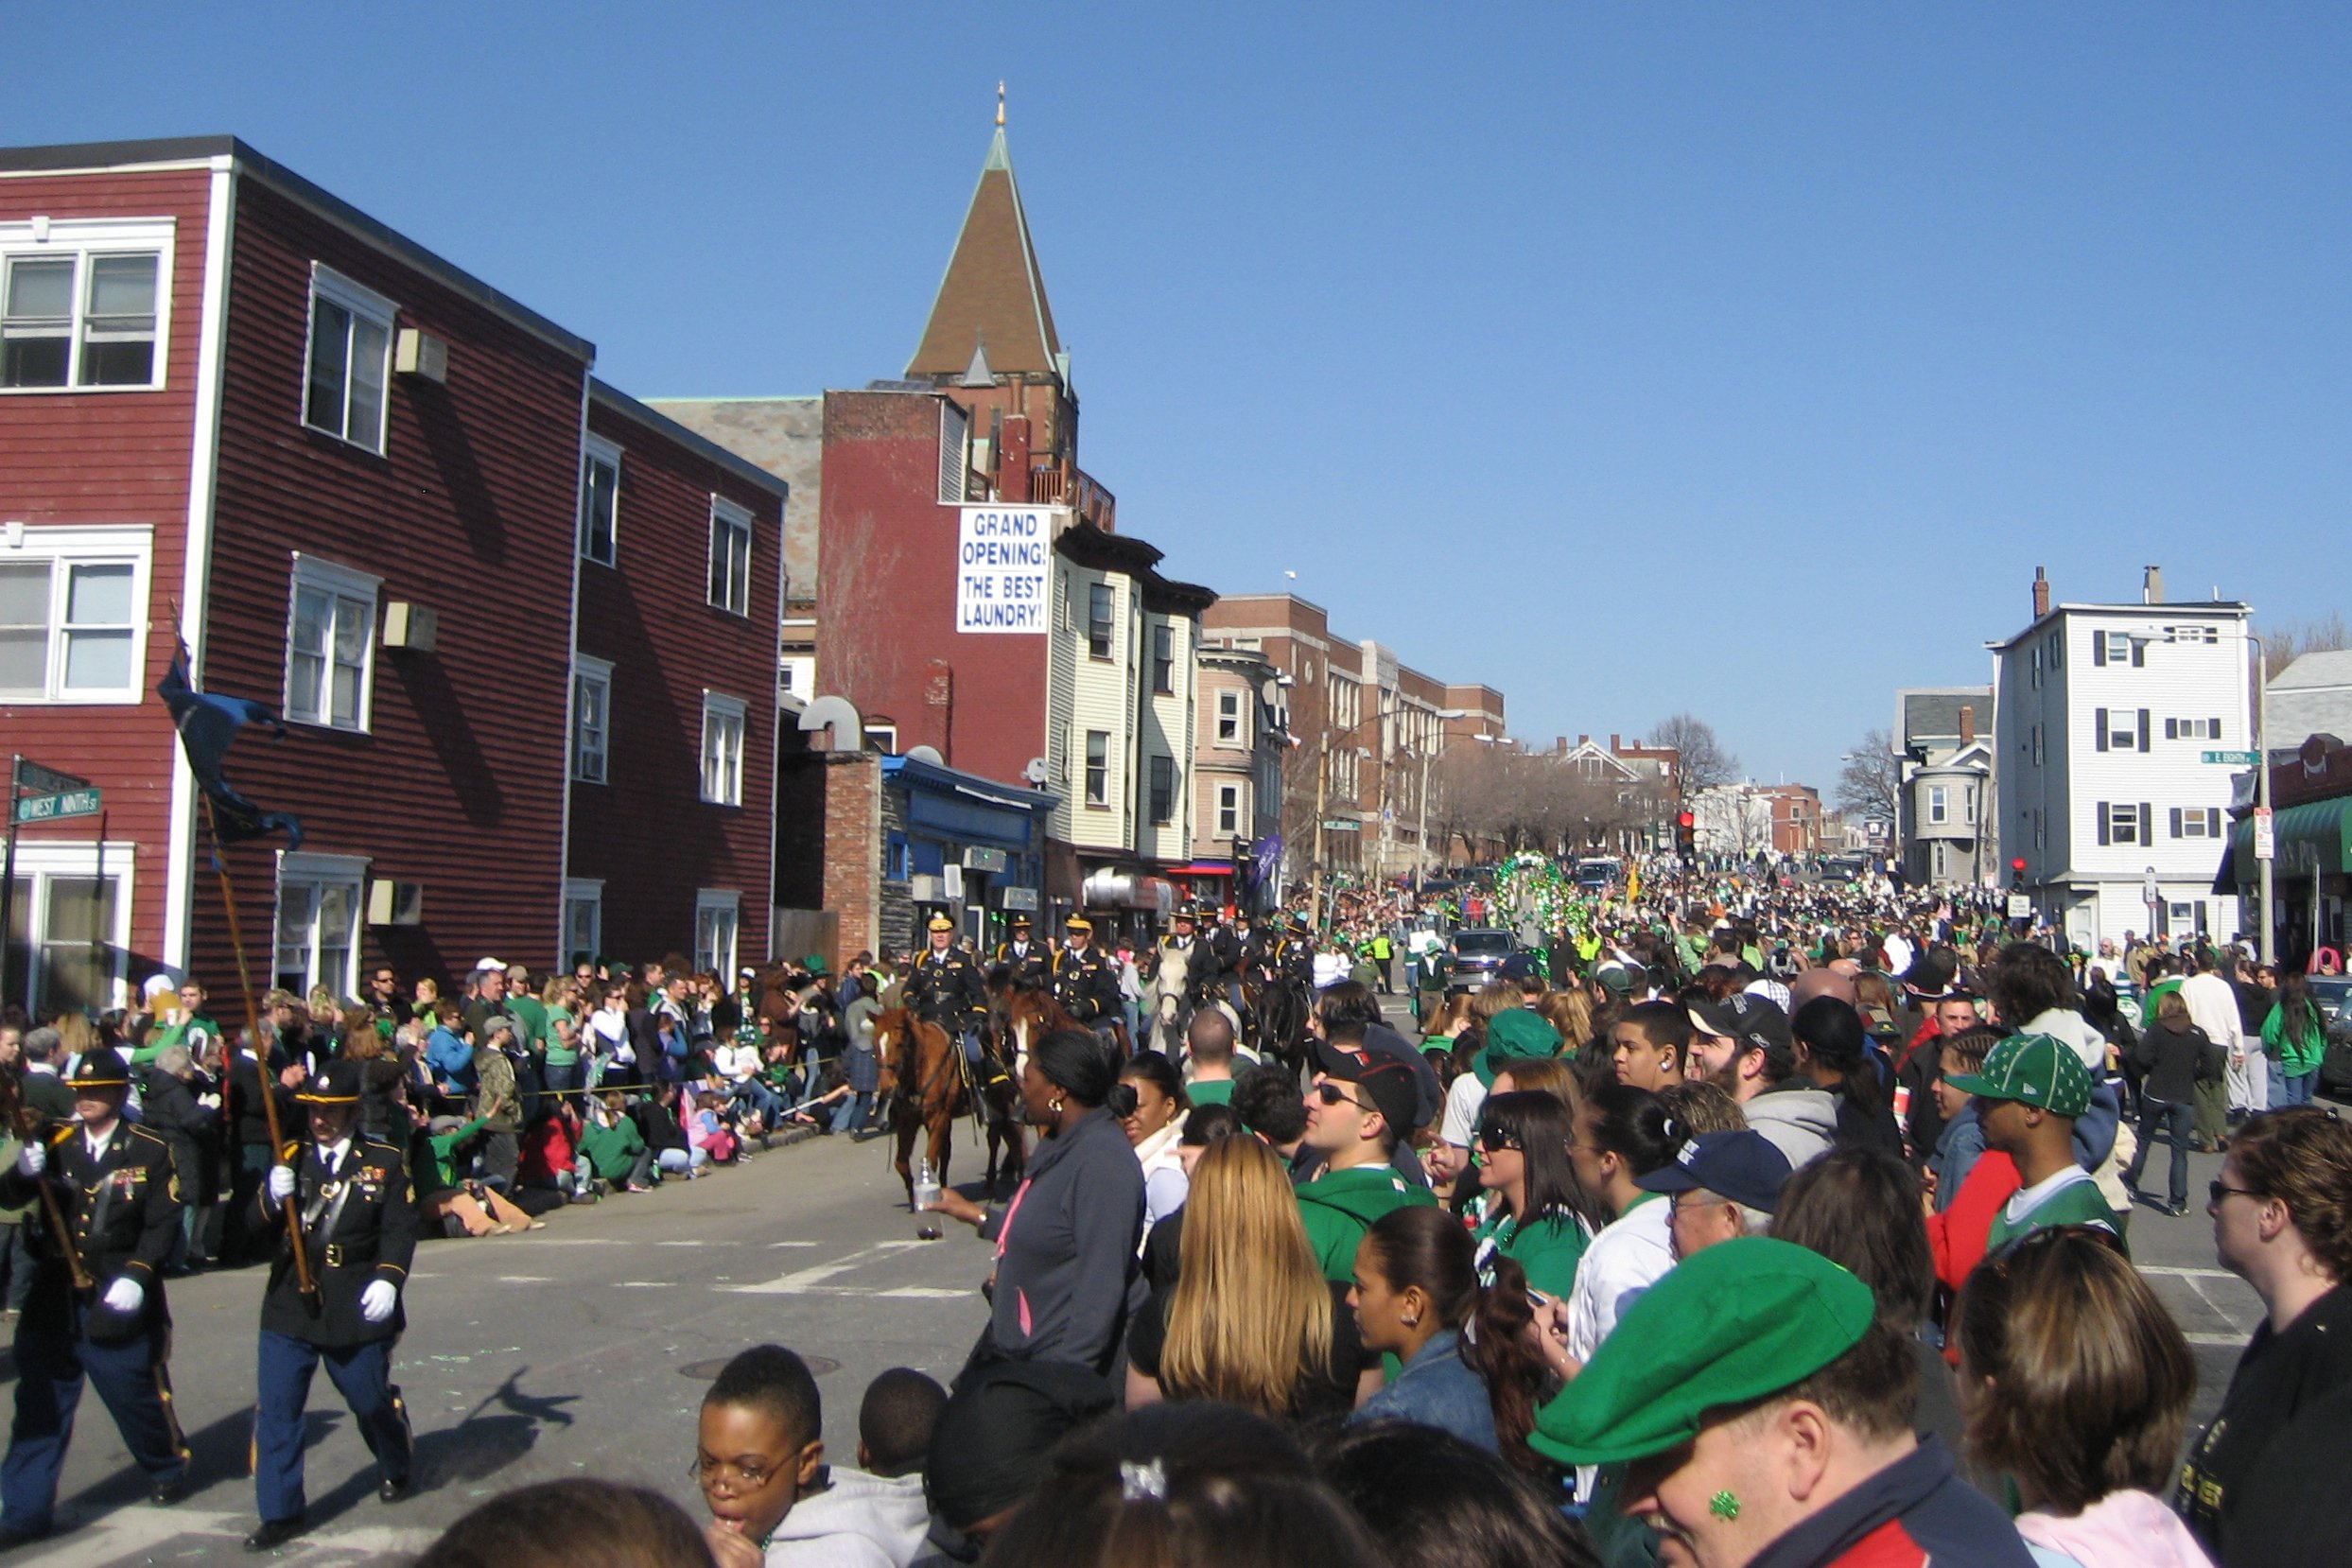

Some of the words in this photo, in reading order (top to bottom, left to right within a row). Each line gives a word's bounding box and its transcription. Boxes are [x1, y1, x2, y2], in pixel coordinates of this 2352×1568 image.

[974, 514, 1037, 536] GRAND
[963, 542, 1047, 566] OPENING!
[965, 576, 993, 599] THE
[1003, 576, 1043, 600] BEST
[963, 603, 1042, 627] LAUNDRY!
